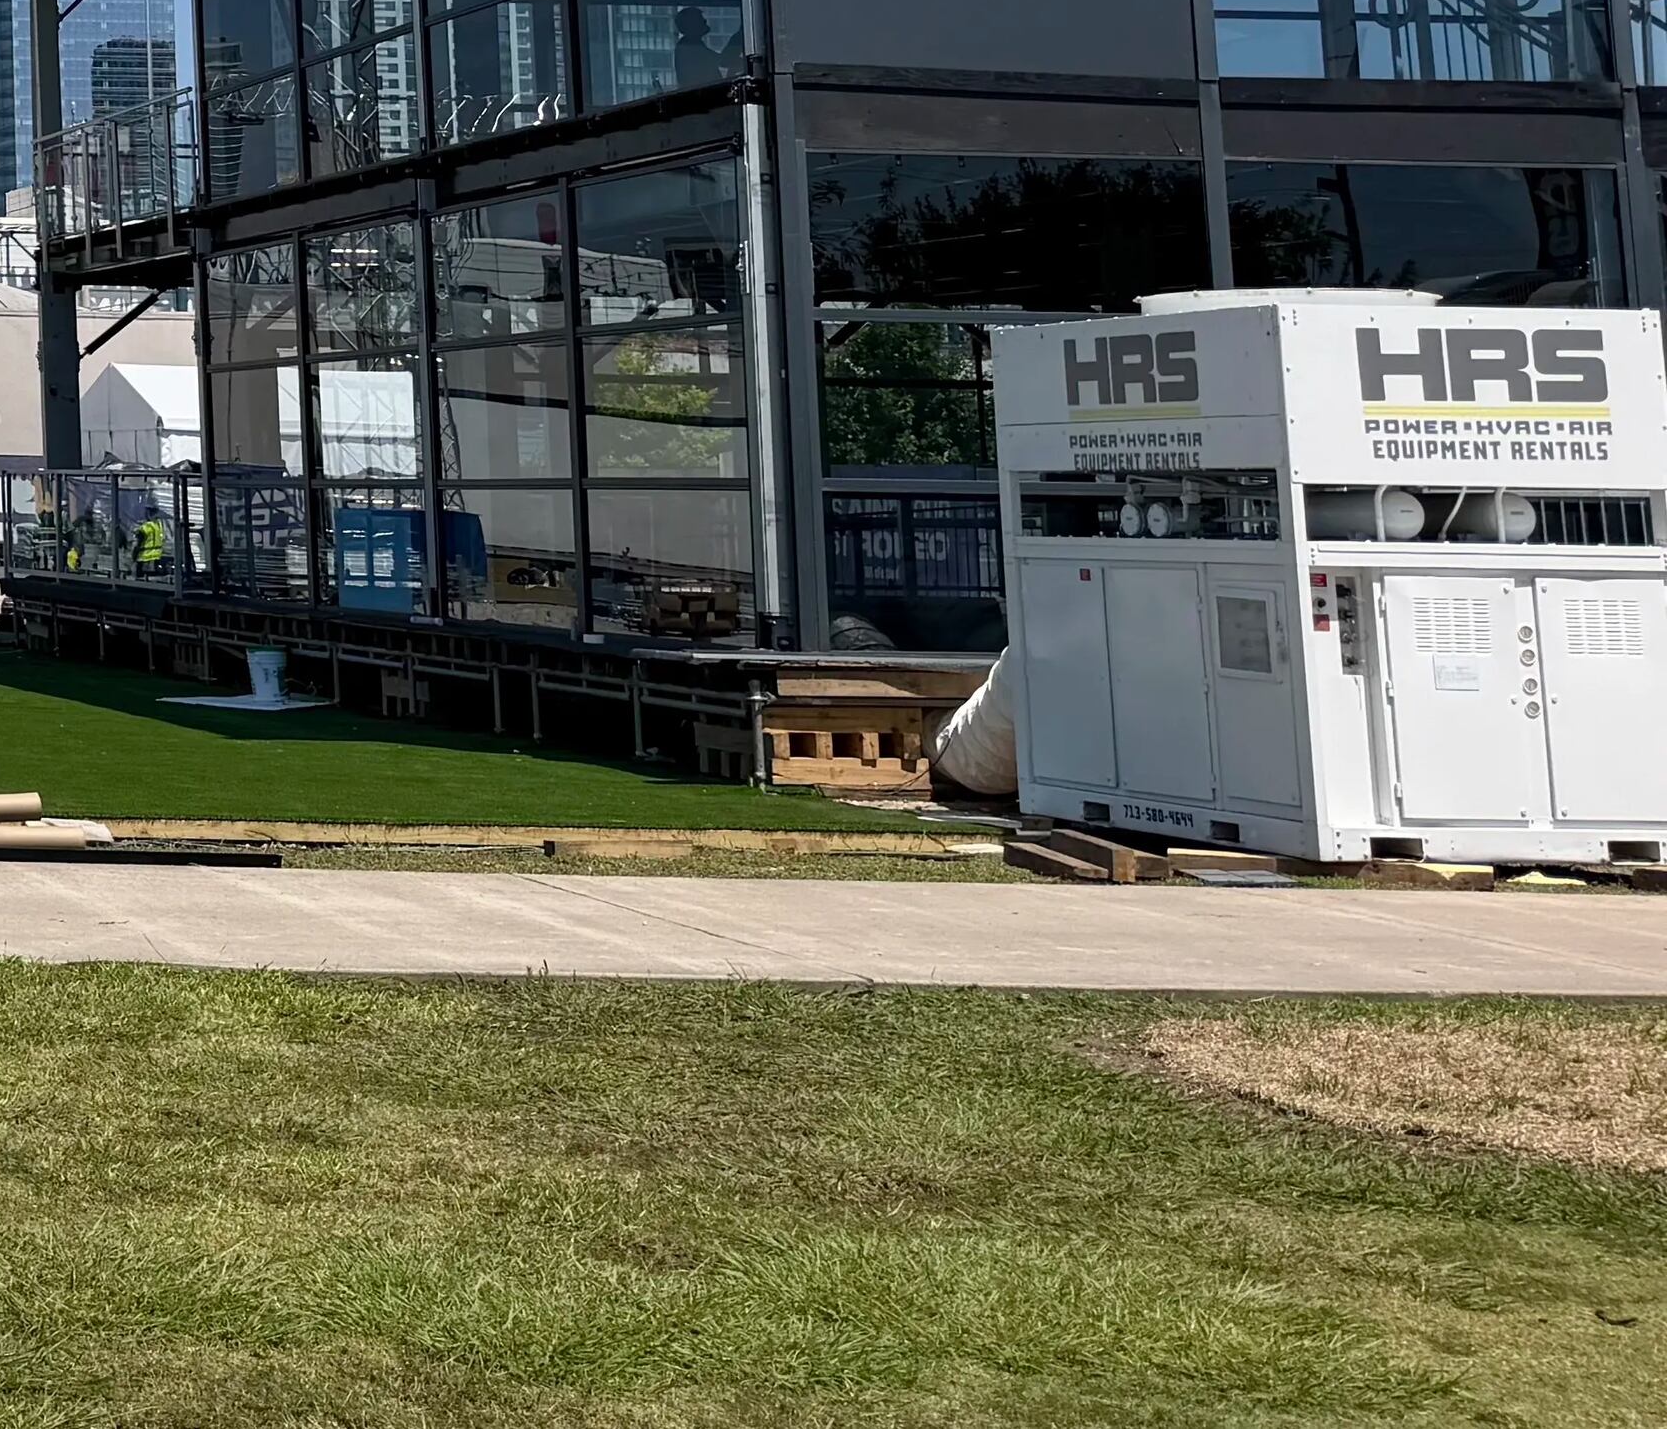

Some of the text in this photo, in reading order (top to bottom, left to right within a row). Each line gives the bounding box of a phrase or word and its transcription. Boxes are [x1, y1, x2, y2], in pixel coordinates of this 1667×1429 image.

[1064, 331, 1199, 406] HRS
[1355, 328, 1609, 402] HRS
[1364, 420, 1612, 435] POWER HVAC AIR
[1373, 440, 1609, 461] EQUIPMENT RENTALS
[1074, 452, 1200, 471] EQUIPMENT RENTALS
